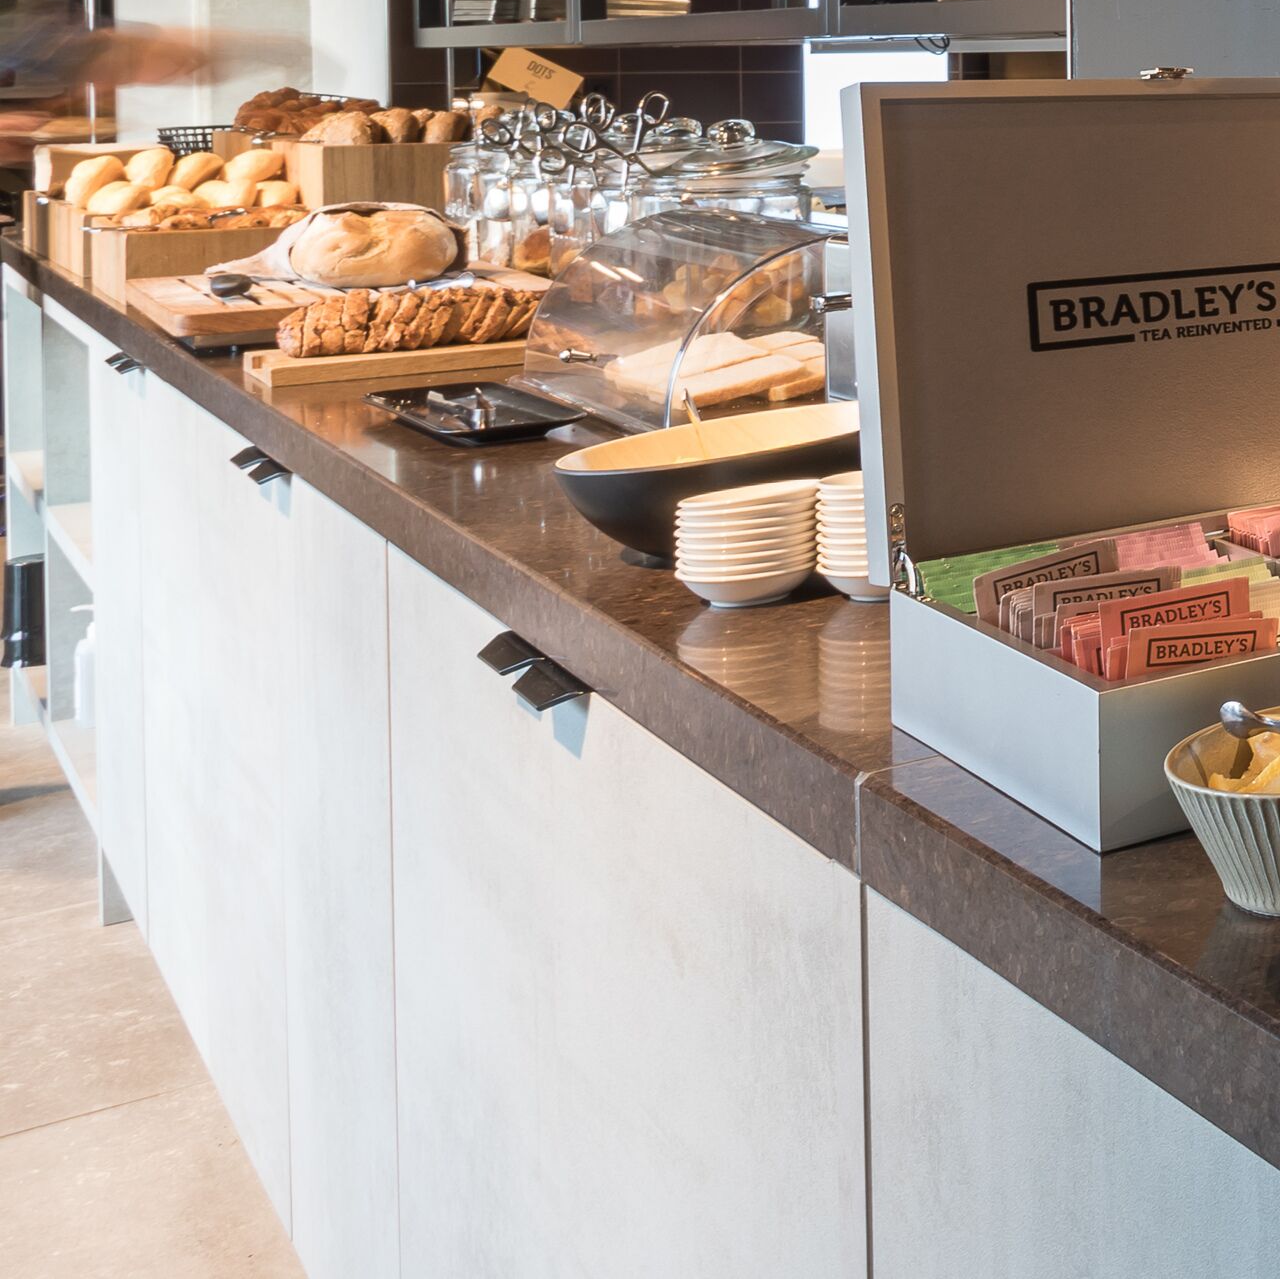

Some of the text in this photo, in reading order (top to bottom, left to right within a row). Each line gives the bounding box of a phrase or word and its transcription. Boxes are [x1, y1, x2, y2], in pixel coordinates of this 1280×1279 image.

[526, 60, 556, 80] DOTS
[1049, 279, 1277, 332] BRADLEY'S
[1140, 318, 1272, 342] TEA REINVENTED
[1129, 599, 1222, 628] BRADLEY'S
[1156, 638, 1248, 659] BRADLEY'S
